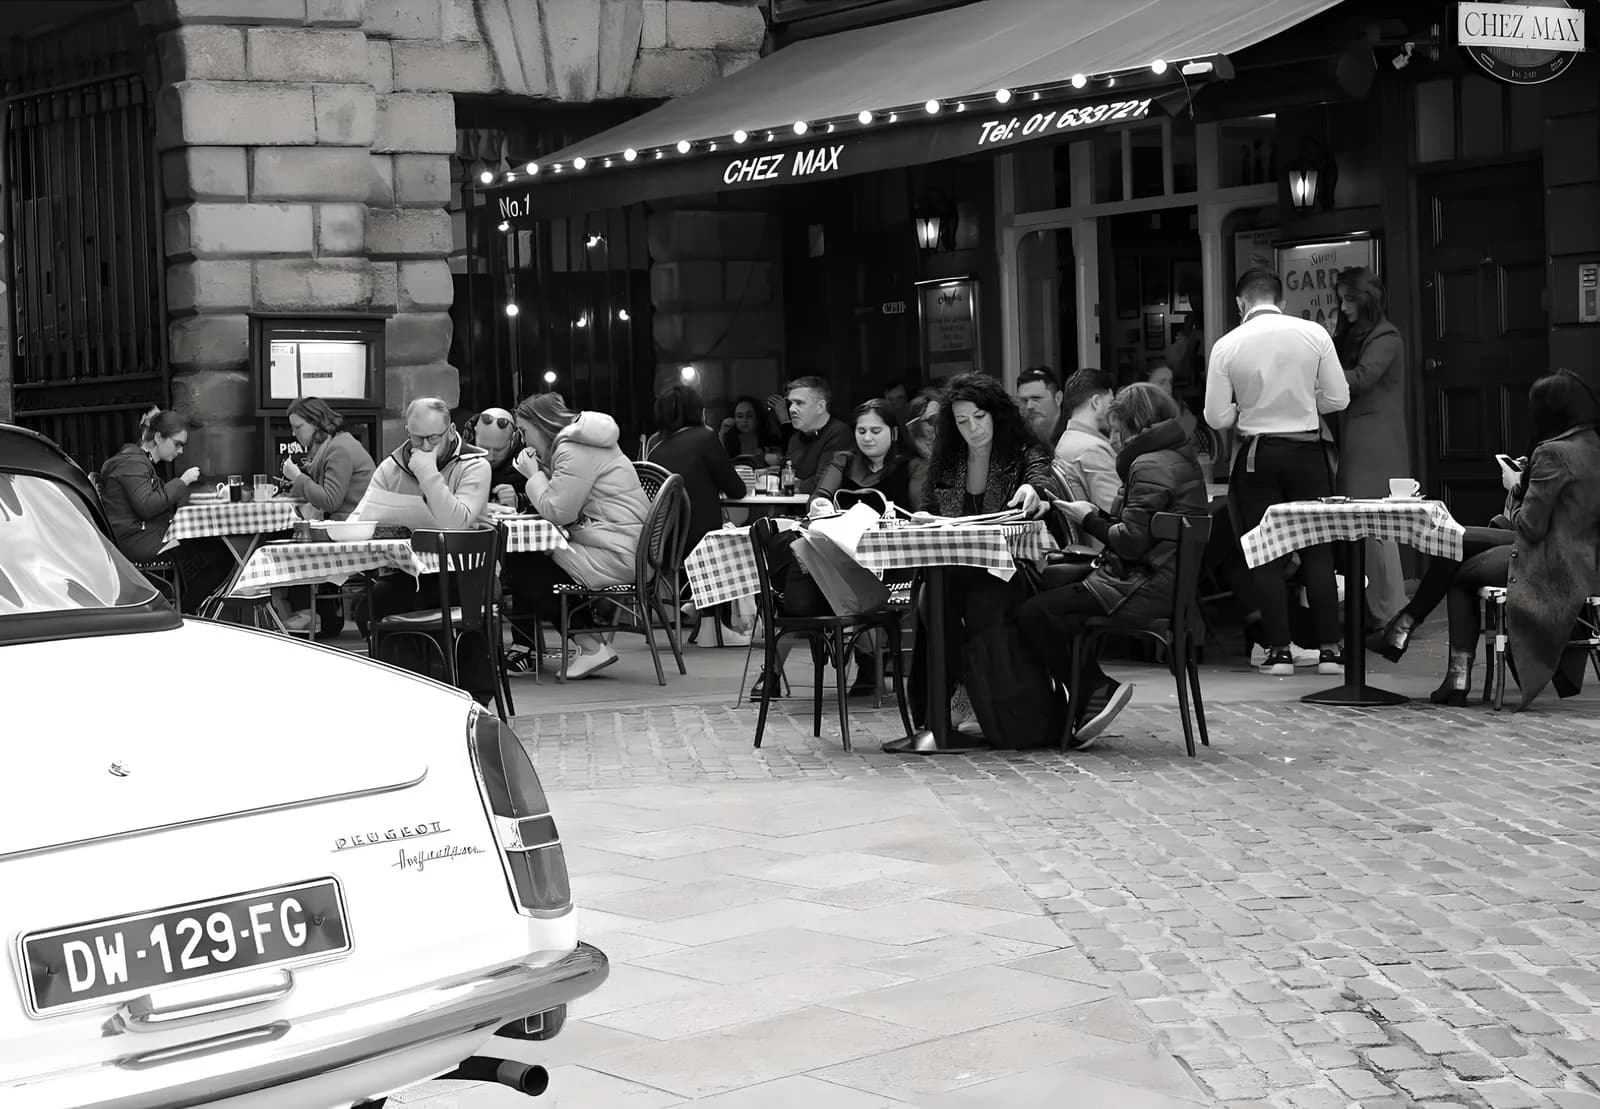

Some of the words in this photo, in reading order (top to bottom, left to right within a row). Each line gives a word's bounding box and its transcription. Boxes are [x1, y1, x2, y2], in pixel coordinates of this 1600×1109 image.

[1464, 11, 1524, 39] CHEZ
[1531, 15, 1580, 42] MAX
[978, 117, 1021, 145] Tel:
[1022, 110, 1057, 136] 01
[1056, 98, 1152, 130] 633721
[723, 153, 785, 184] CHEZ
[791, 144, 845, 176] MAX
[499, 192, 530, 219] No.1
[1286, 267, 1341, 291] GARD
[334, 821, 442, 850] PEUGEOT
[62, 897, 308, 993] DW-129-FG
